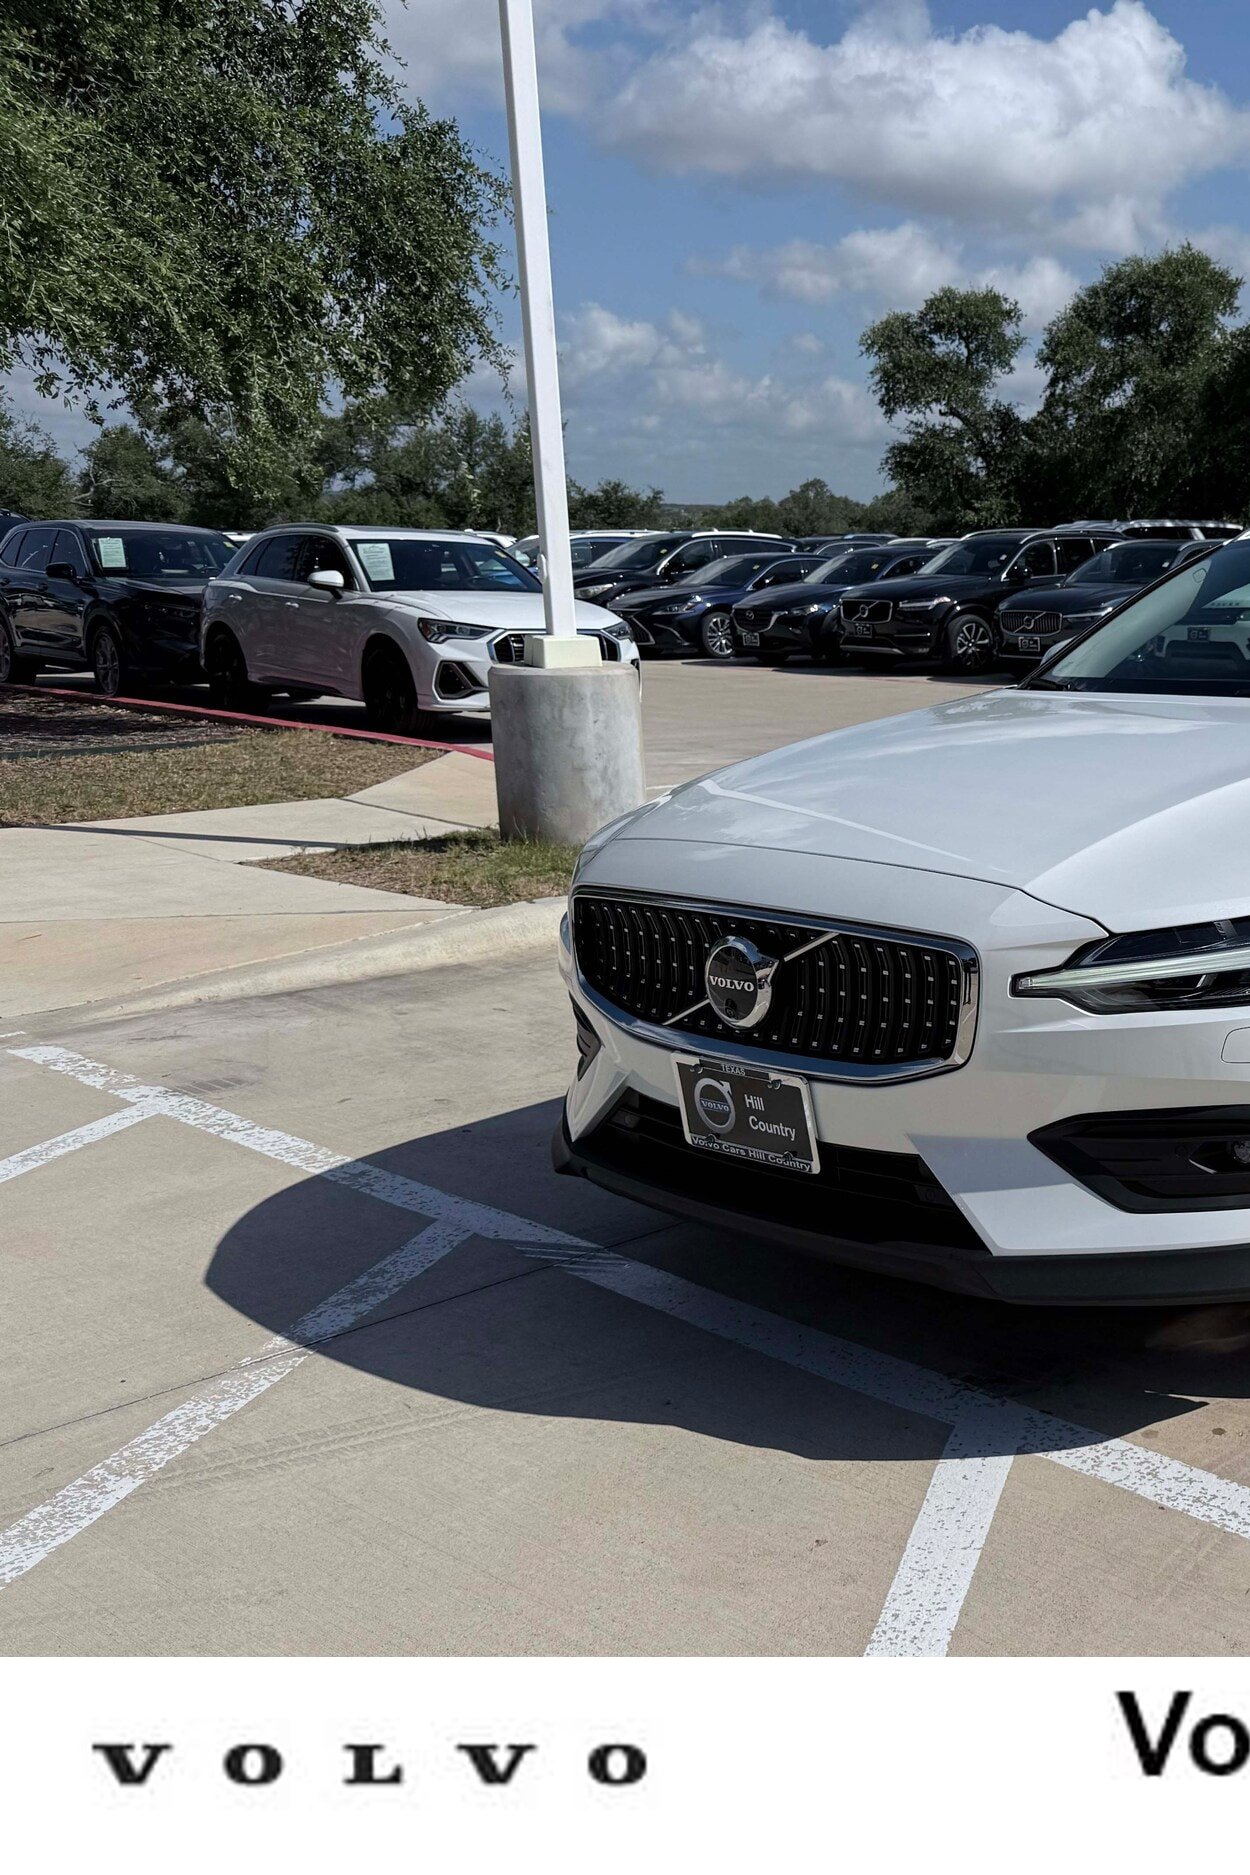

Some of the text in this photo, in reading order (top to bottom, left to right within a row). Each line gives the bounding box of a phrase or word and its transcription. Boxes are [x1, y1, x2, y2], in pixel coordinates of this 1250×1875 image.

[709, 975, 755, 992] VOLVO
[721, 1064, 746, 1076] TEXAS
[701, 1099, 730, 1112] VOLVO
[744, 1094, 765, 1111] Hill
[748, 1116, 796, 1141] Country
[692, 1136, 811, 1172] Vovo Cars Hill Country
